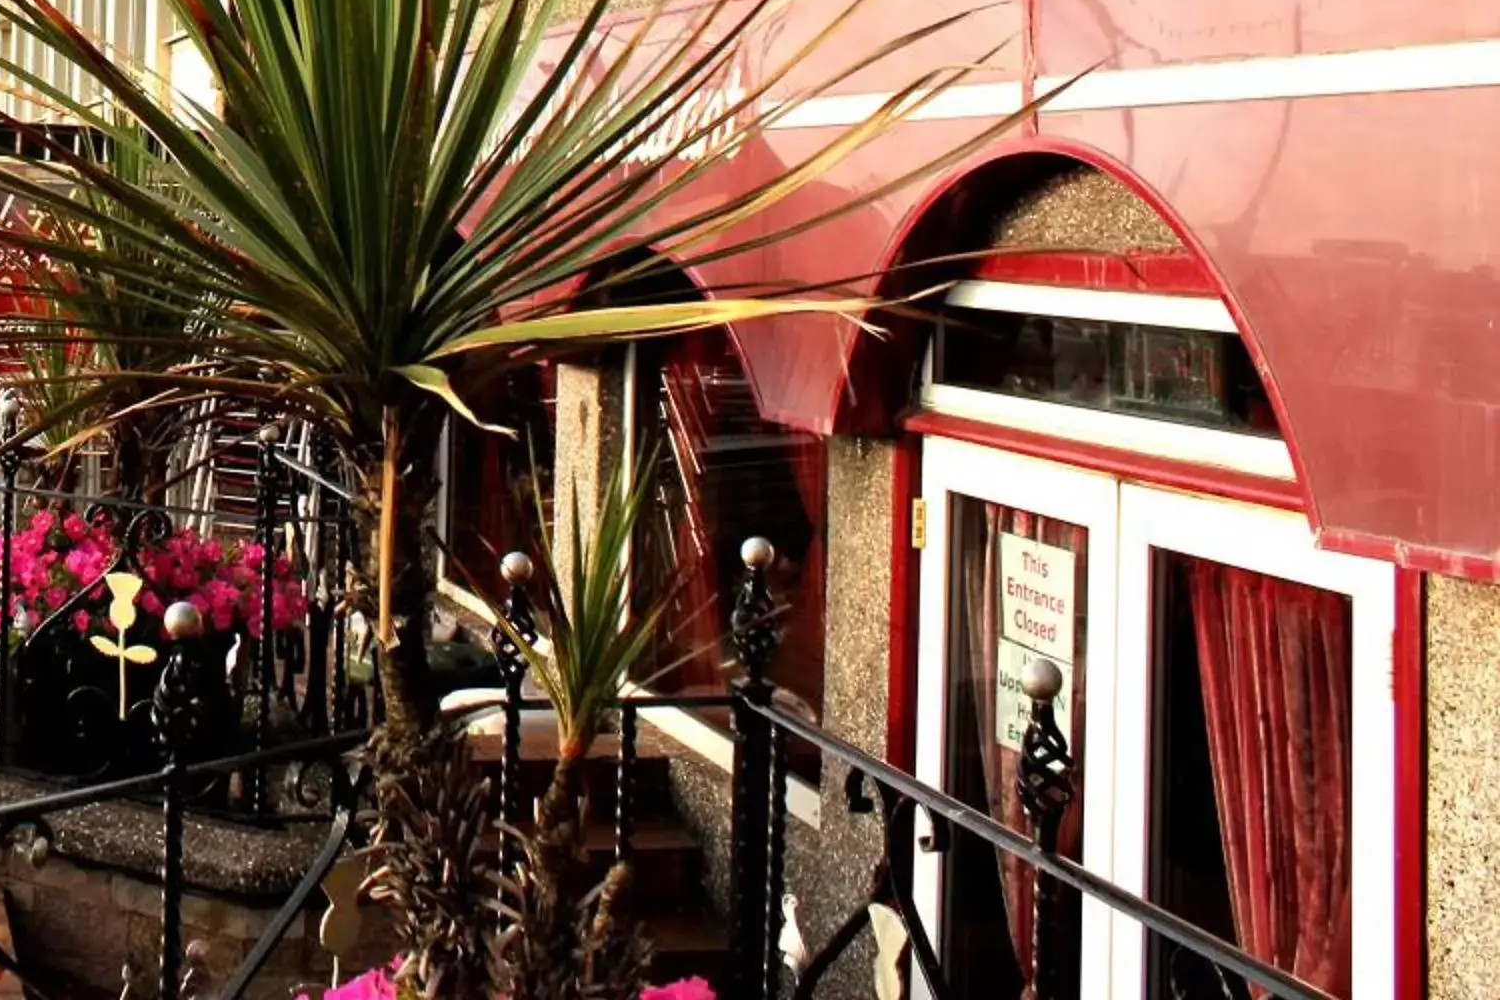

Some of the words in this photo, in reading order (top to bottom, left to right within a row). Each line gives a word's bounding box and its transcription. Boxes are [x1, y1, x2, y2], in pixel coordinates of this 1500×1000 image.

[1021, 551, 1049, 579] This
[1007, 576, 1065, 615] Entrance
[1014, 609, 1057, 643] Closed
